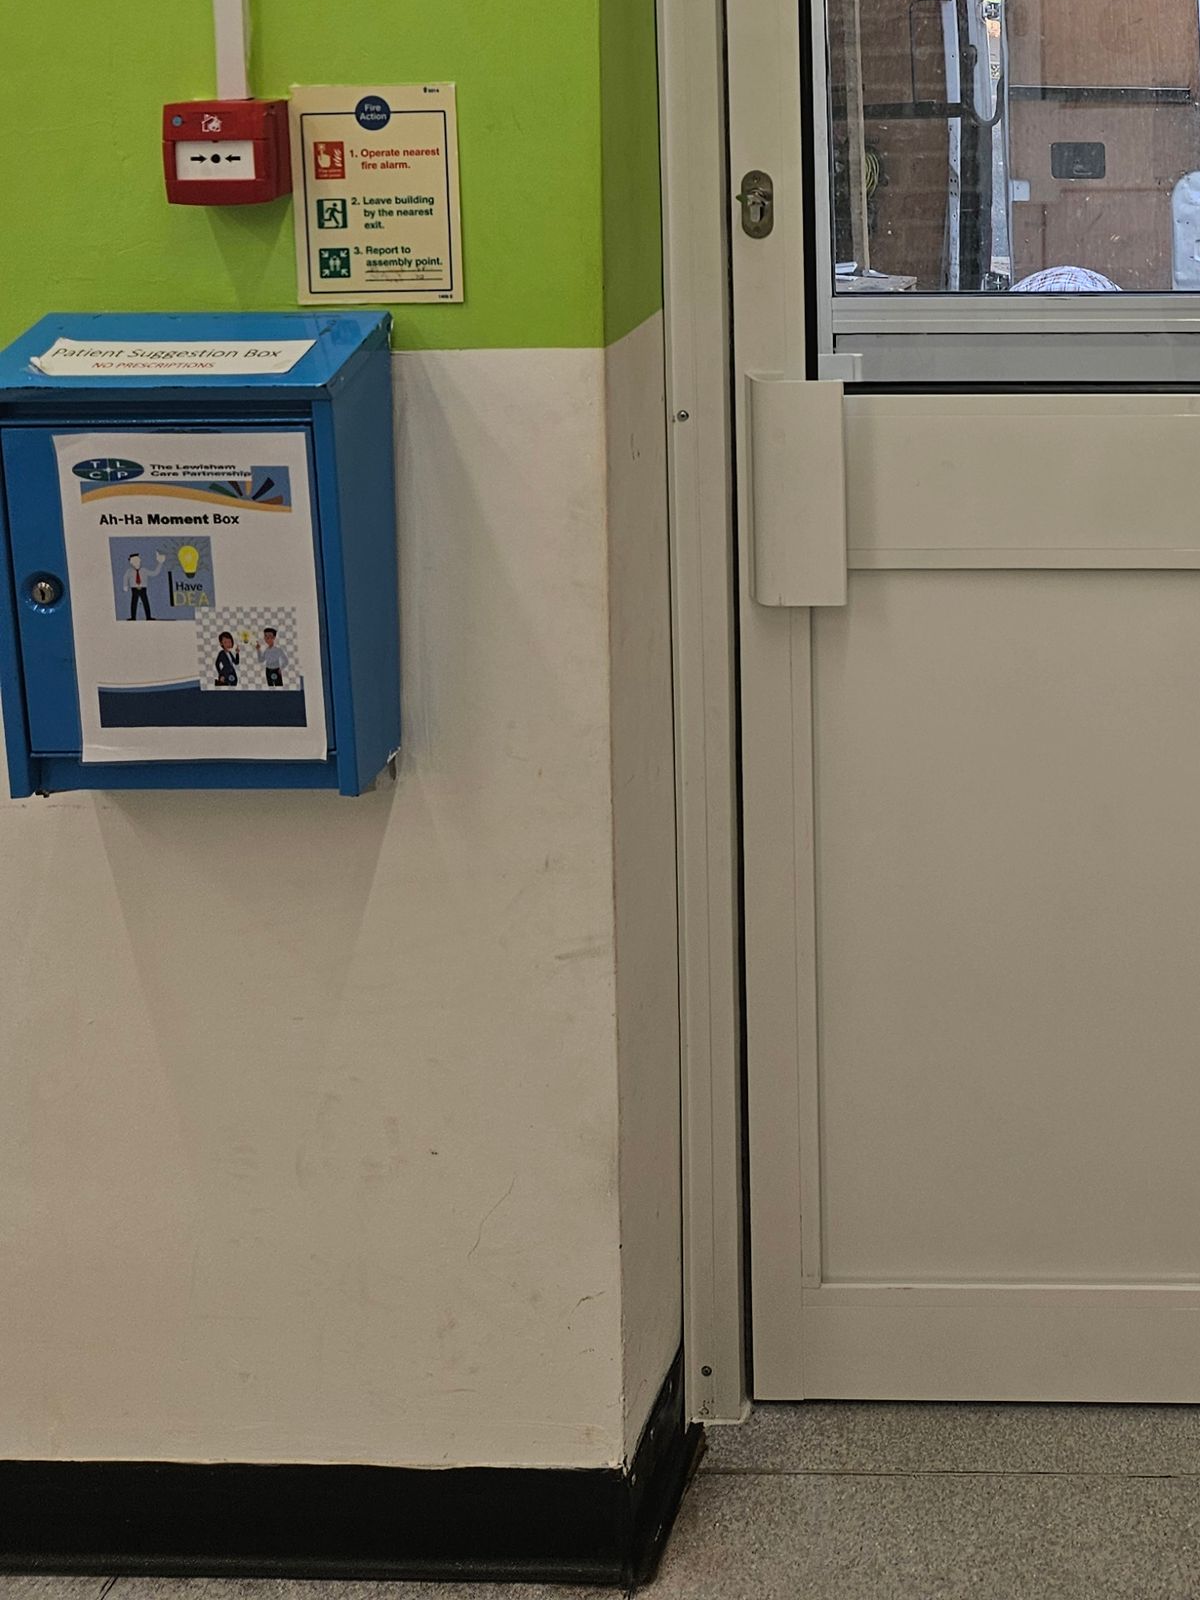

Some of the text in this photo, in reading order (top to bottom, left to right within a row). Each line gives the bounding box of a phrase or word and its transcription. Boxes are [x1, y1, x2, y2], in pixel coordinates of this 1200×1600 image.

[364, 103, 382, 112] Fire
[360, 112, 387, 121] Action
[350, 148, 440, 159] 1. Operate nearest
[361, 160, 411, 170] fire alarm.
[351, 196, 434, 206] 2. Leave building
[363, 208, 433, 218] by the nearest
[364, 221, 385, 230] exit.
[354, 246, 411, 256] 3. Report to
[366, 257, 443, 267] assembly point.
[51, 348, 283, 360] Patient Suggestion Box
[89, 471, 128, 479] C P
[99, 513, 239, 526] Ah-Ha Moment Box
[175, 581, 203, 591] Have
